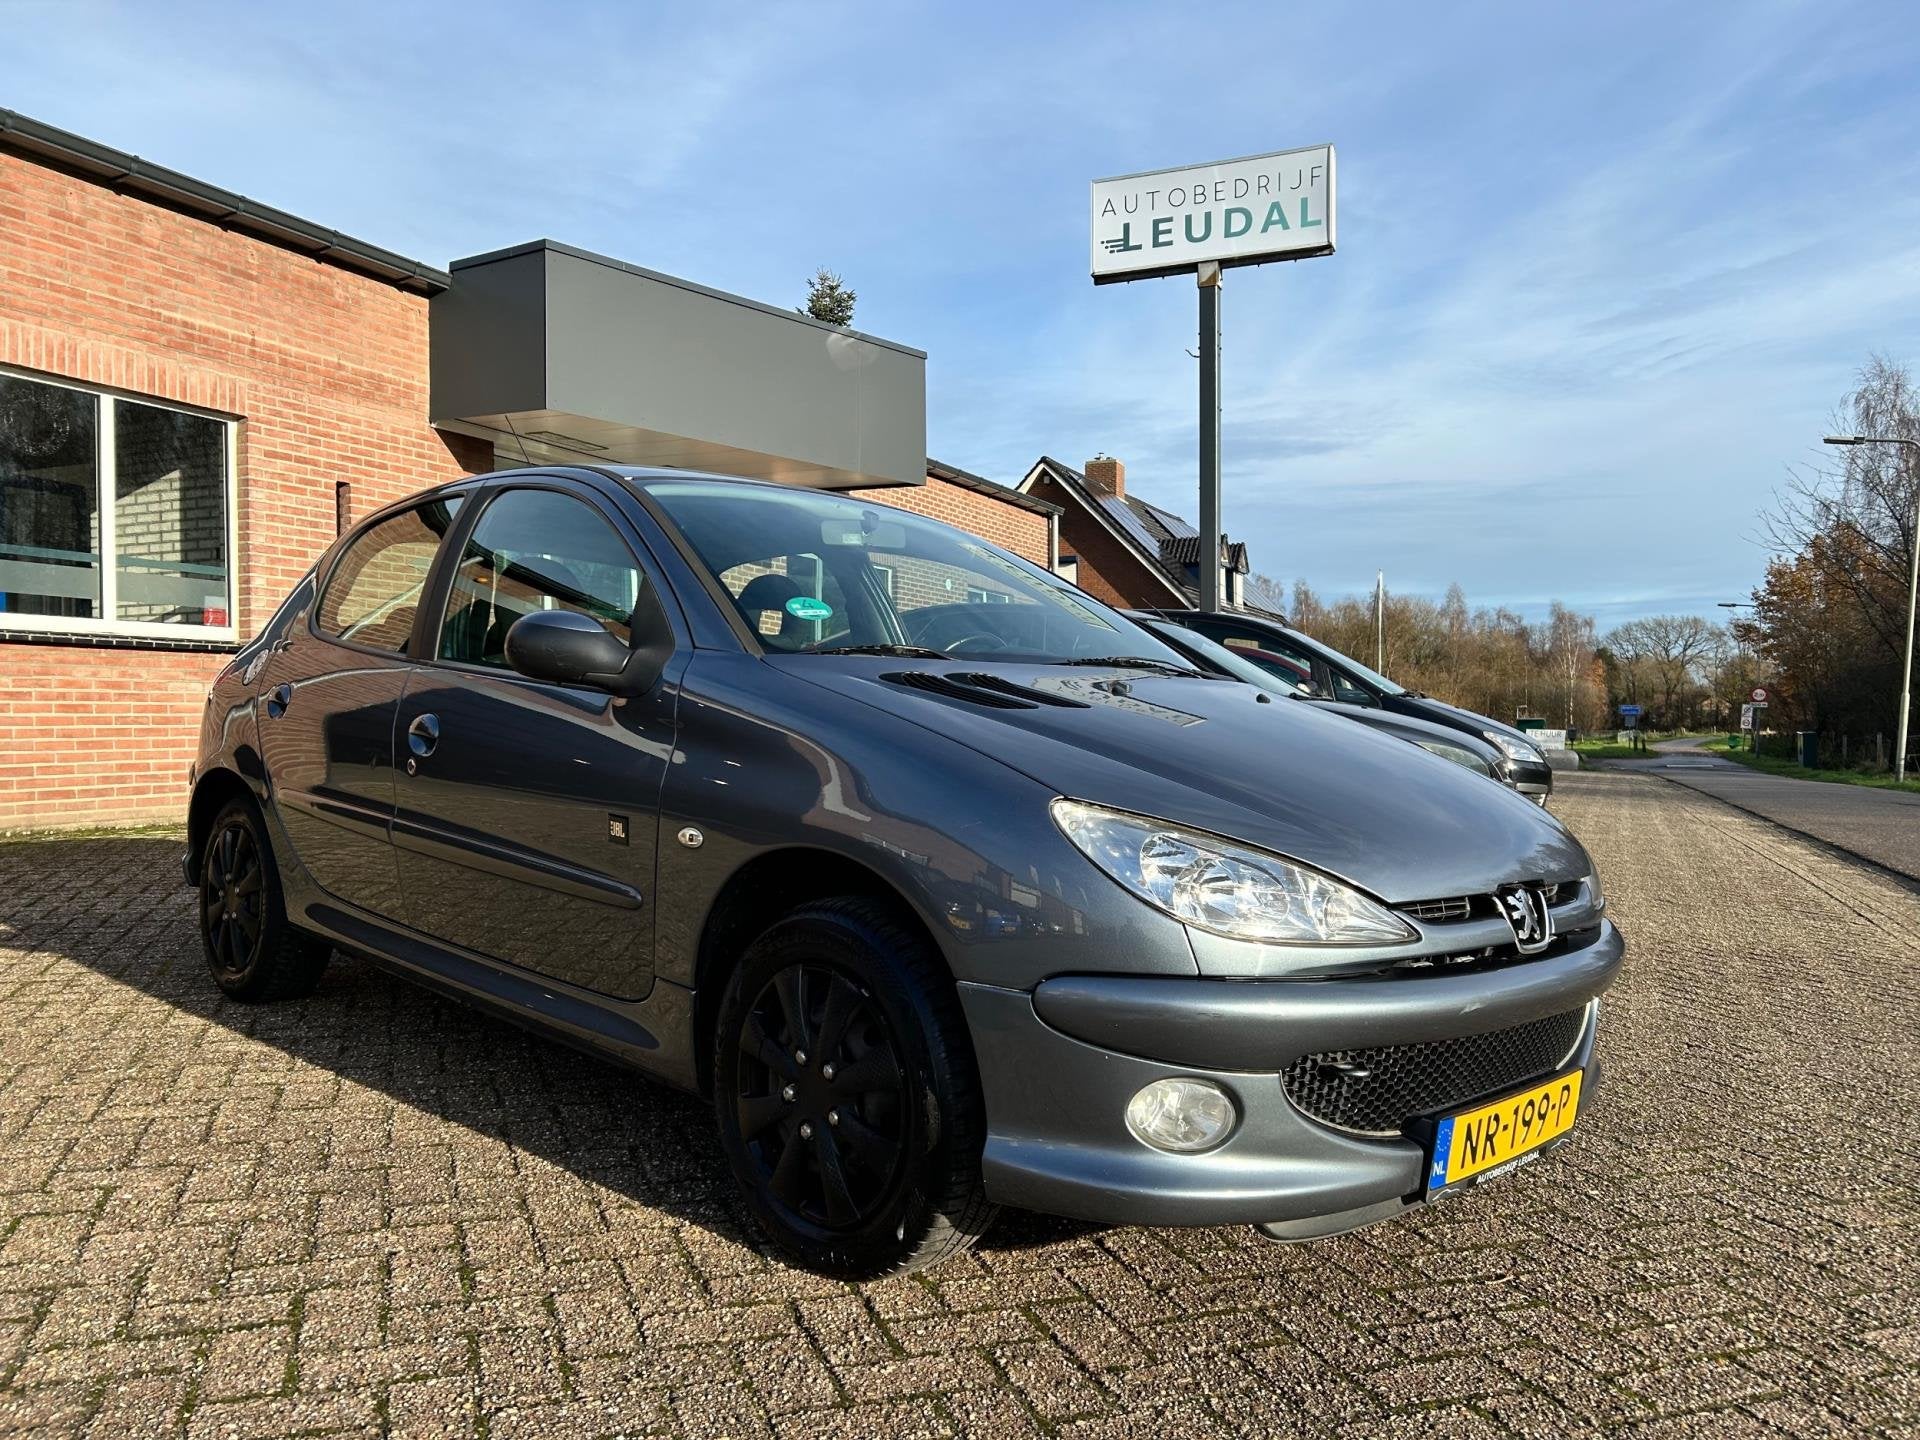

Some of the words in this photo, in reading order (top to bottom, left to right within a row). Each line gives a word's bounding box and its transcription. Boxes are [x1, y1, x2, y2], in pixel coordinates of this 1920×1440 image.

[1101, 165, 1323, 218] AUTOBEDRIJF
[1116, 196, 1322, 253] LEUDAL
[610, 821, 625, 838] JBL
[1460, 1084, 1571, 1170] NR-199-P
[1432, 1161, 1445, 1176] NL
[1476, 1159, 1518, 1184] AUTOBEDRIJF
[1518, 1150, 1540, 1167] LEUDAL
